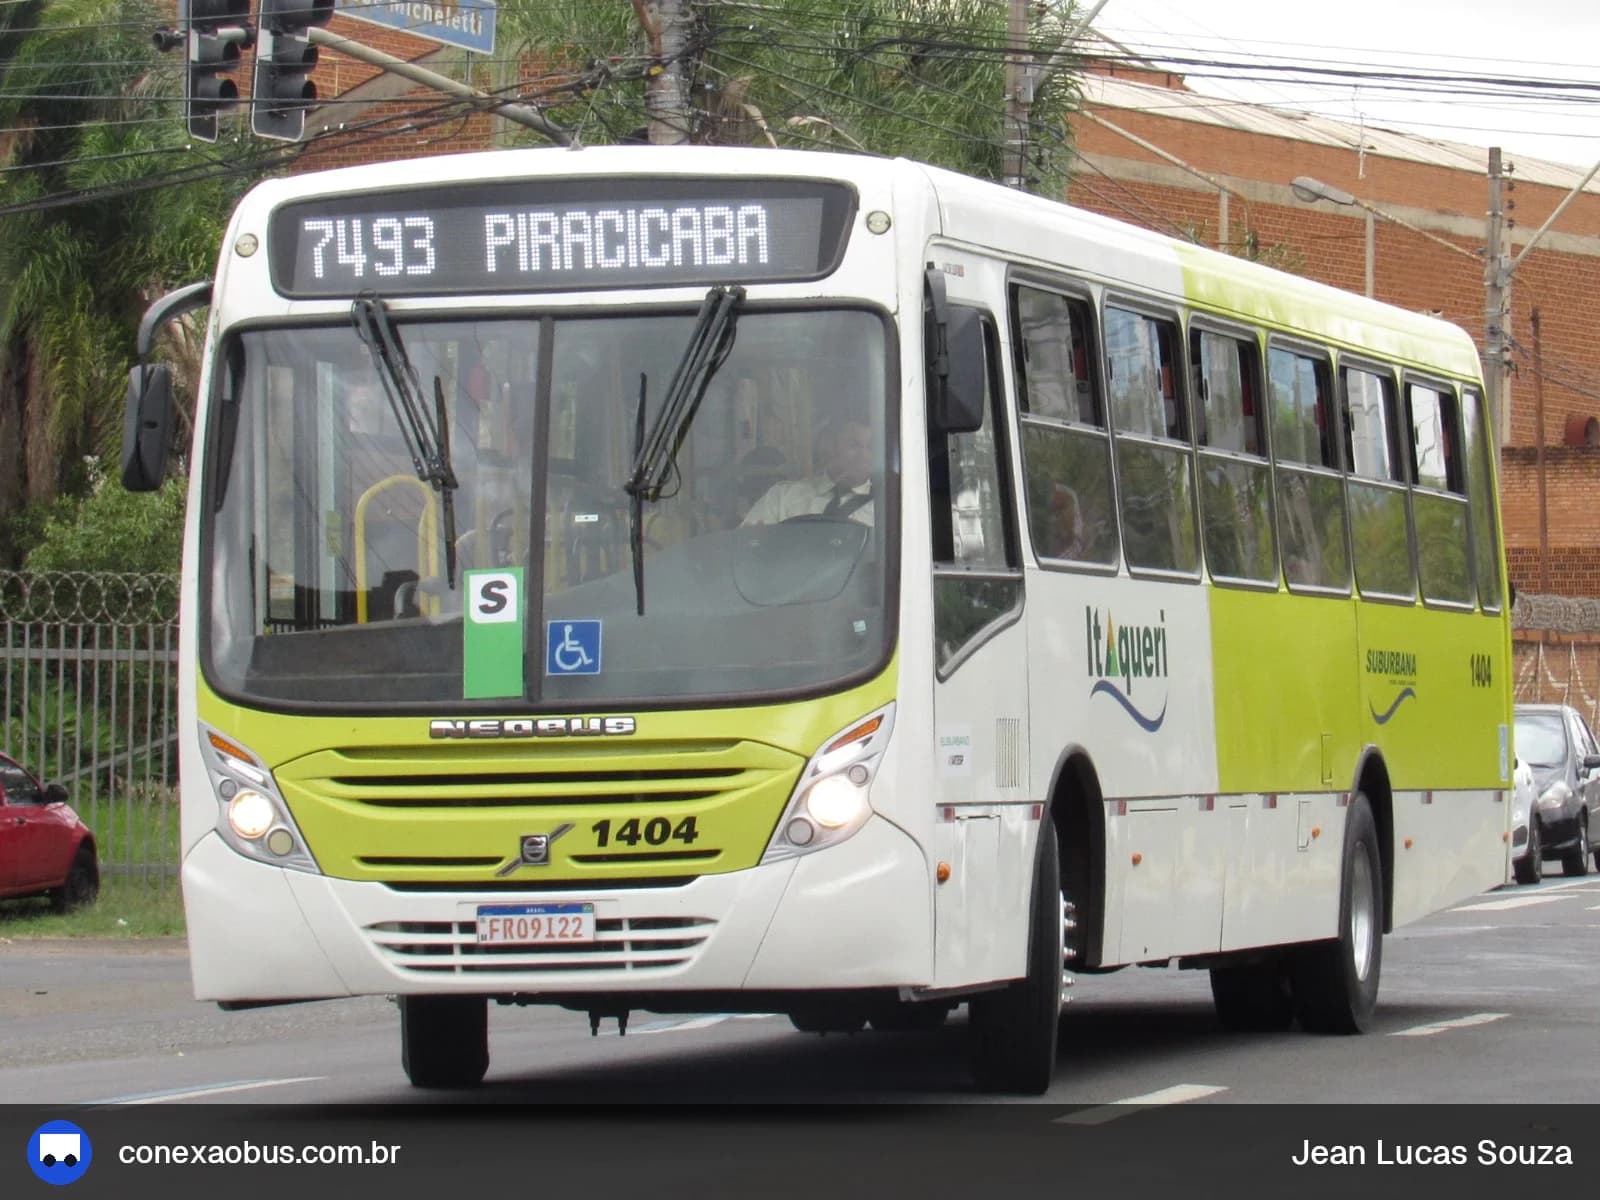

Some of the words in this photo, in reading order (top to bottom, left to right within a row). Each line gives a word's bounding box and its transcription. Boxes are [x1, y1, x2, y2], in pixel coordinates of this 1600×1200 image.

[303, 216, 436, 279] 7493
[484, 205, 769, 273] PIRACICABA
[478, 580, 509, 614] S
[1366, 649, 1417, 677] SUBURBANA
[1470, 653, 1492, 688] 1404
[429, 716, 636, 738] NEOBUS
[592, 816, 699, 848] 1404
